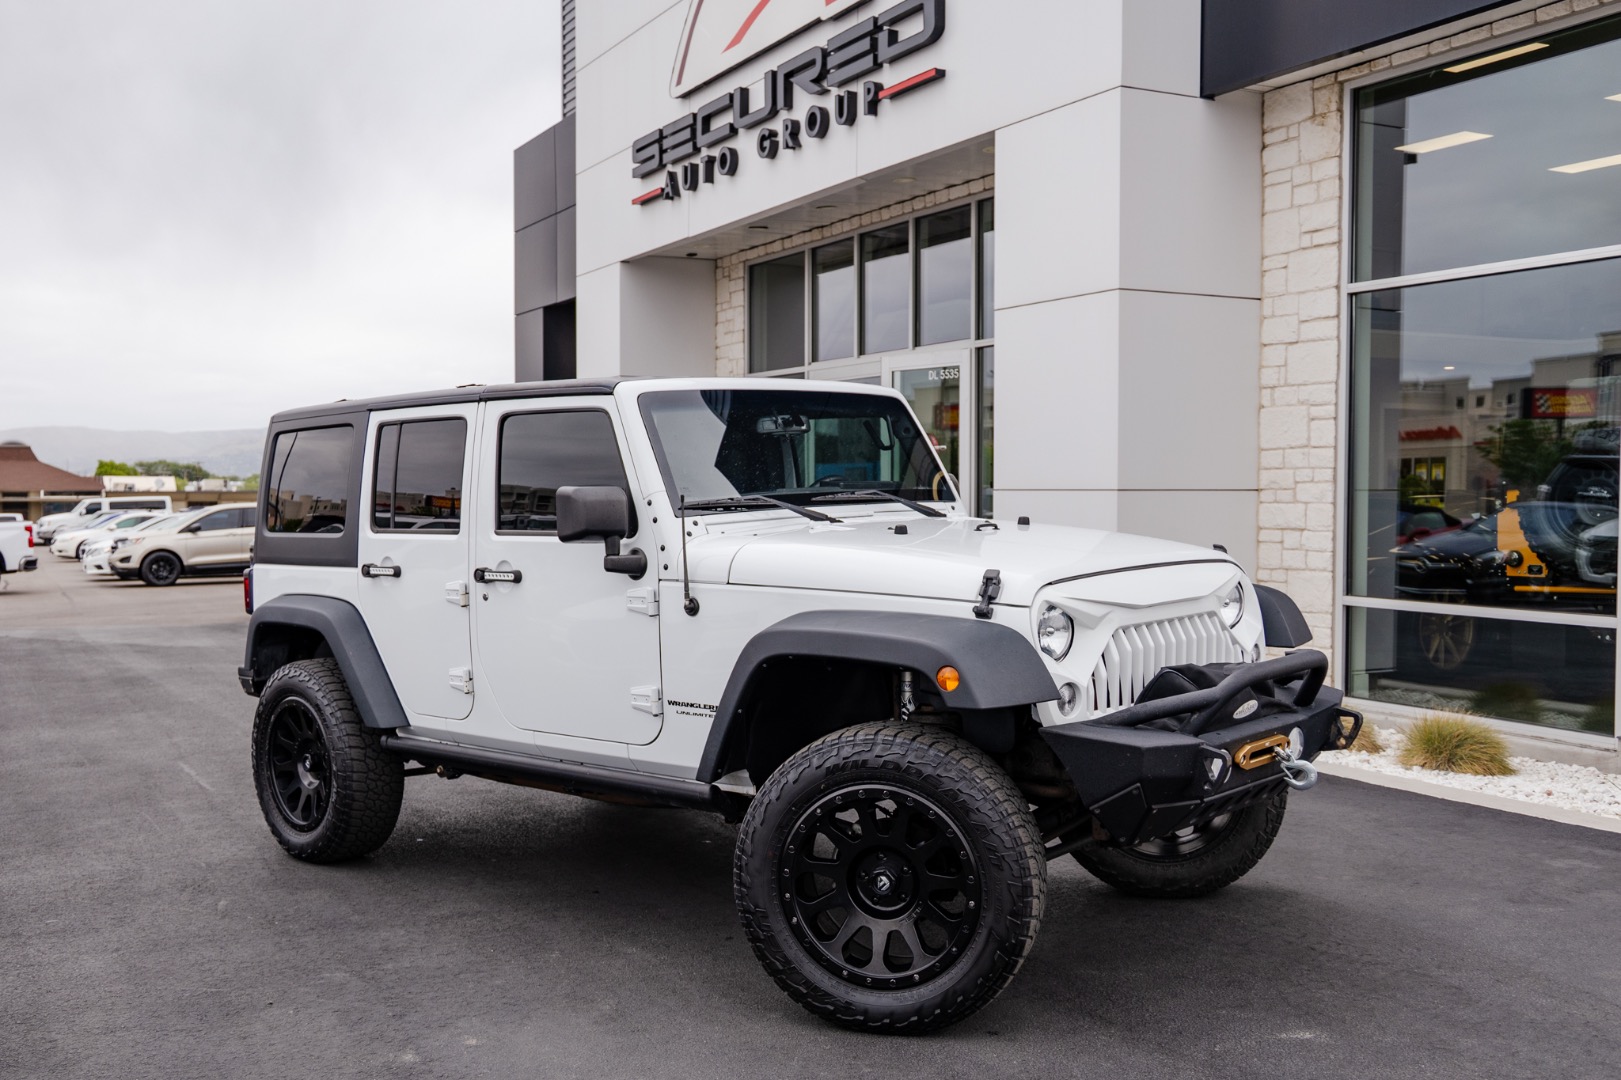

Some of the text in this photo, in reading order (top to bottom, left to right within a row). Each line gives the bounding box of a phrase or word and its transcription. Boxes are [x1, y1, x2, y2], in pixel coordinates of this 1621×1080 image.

[632, 0, 946, 179] SECURED
[663, 80, 884, 201] AUTO GROUP
[928, 368, 960, 381] DL 5535
[676, 709, 716, 718] UNLIMITE
